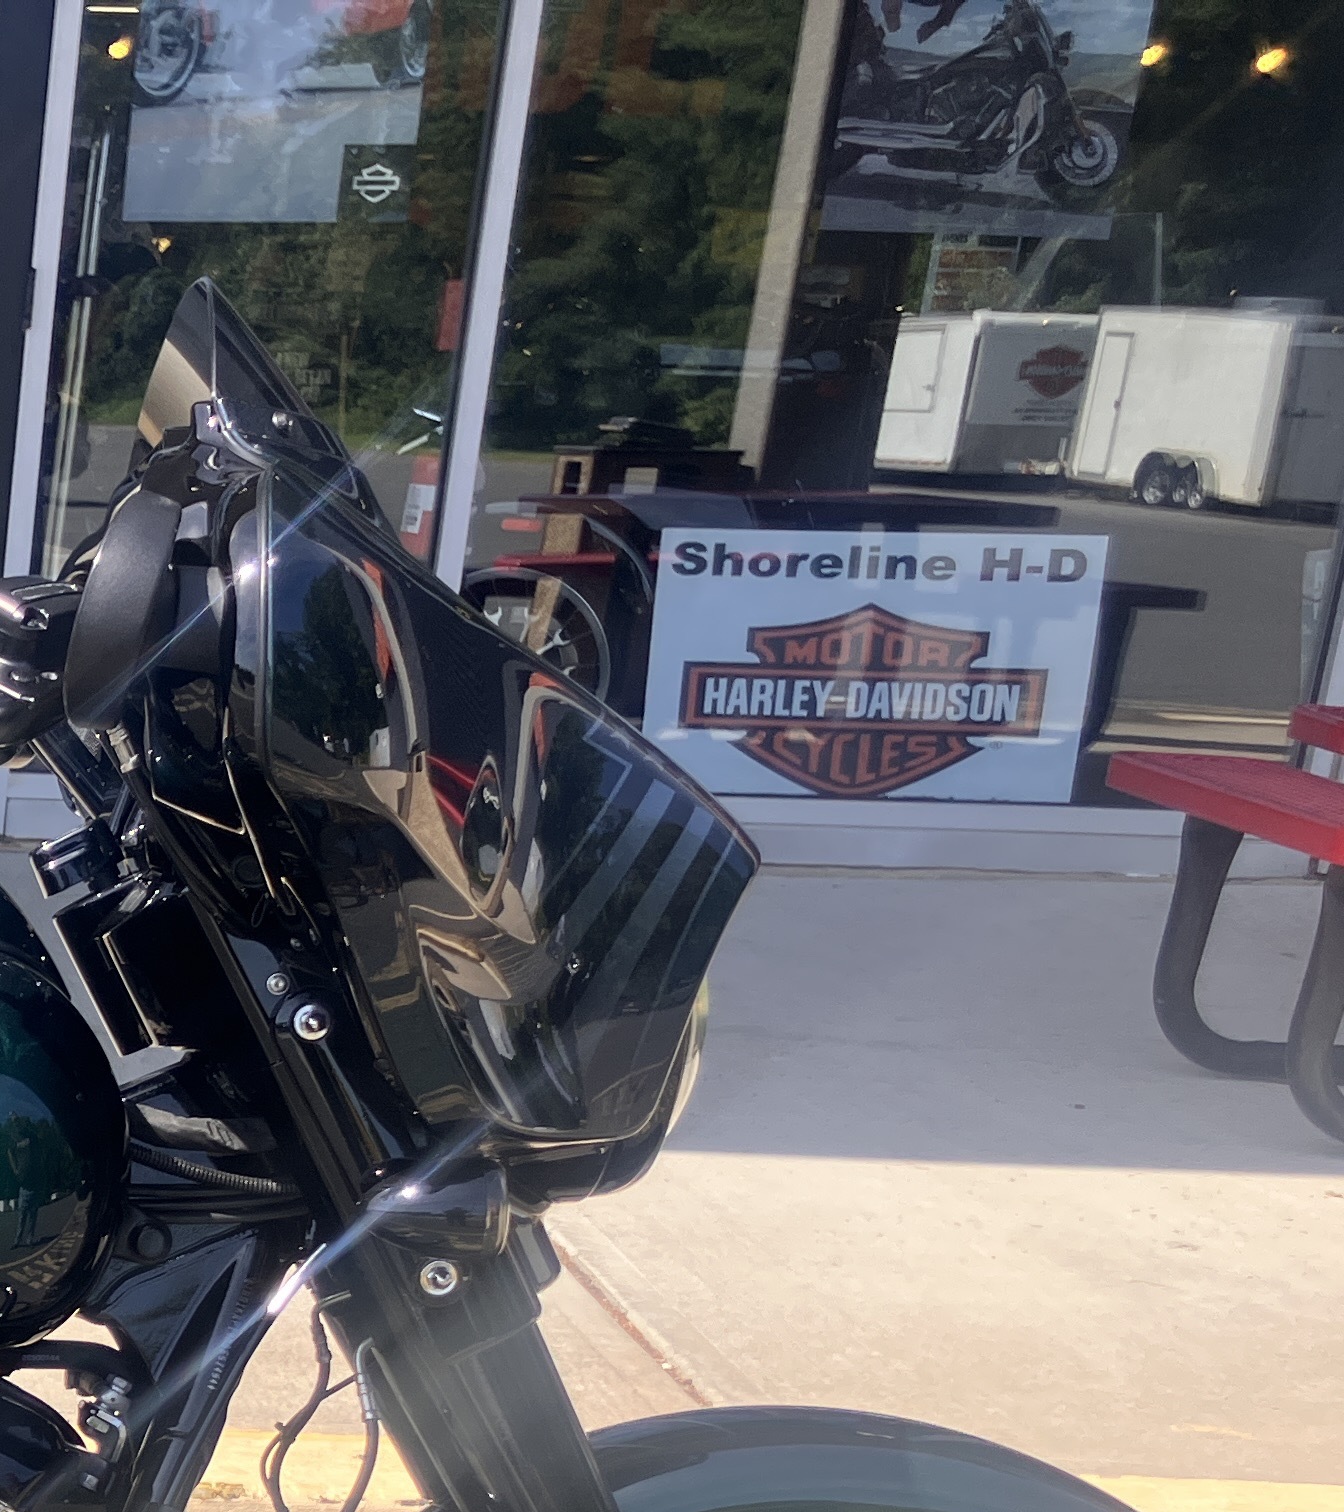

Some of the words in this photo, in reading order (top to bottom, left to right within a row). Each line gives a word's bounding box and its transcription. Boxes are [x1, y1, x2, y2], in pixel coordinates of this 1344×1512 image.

[671, 541, 957, 580] Shoreline
[979, 546, 1088, 583] H-D
[783, 627, 952, 669] MOTOR
[702, 675, 1022, 723] HARLEY-DAVIDSON
[770, 729, 941, 786] CYCLES
